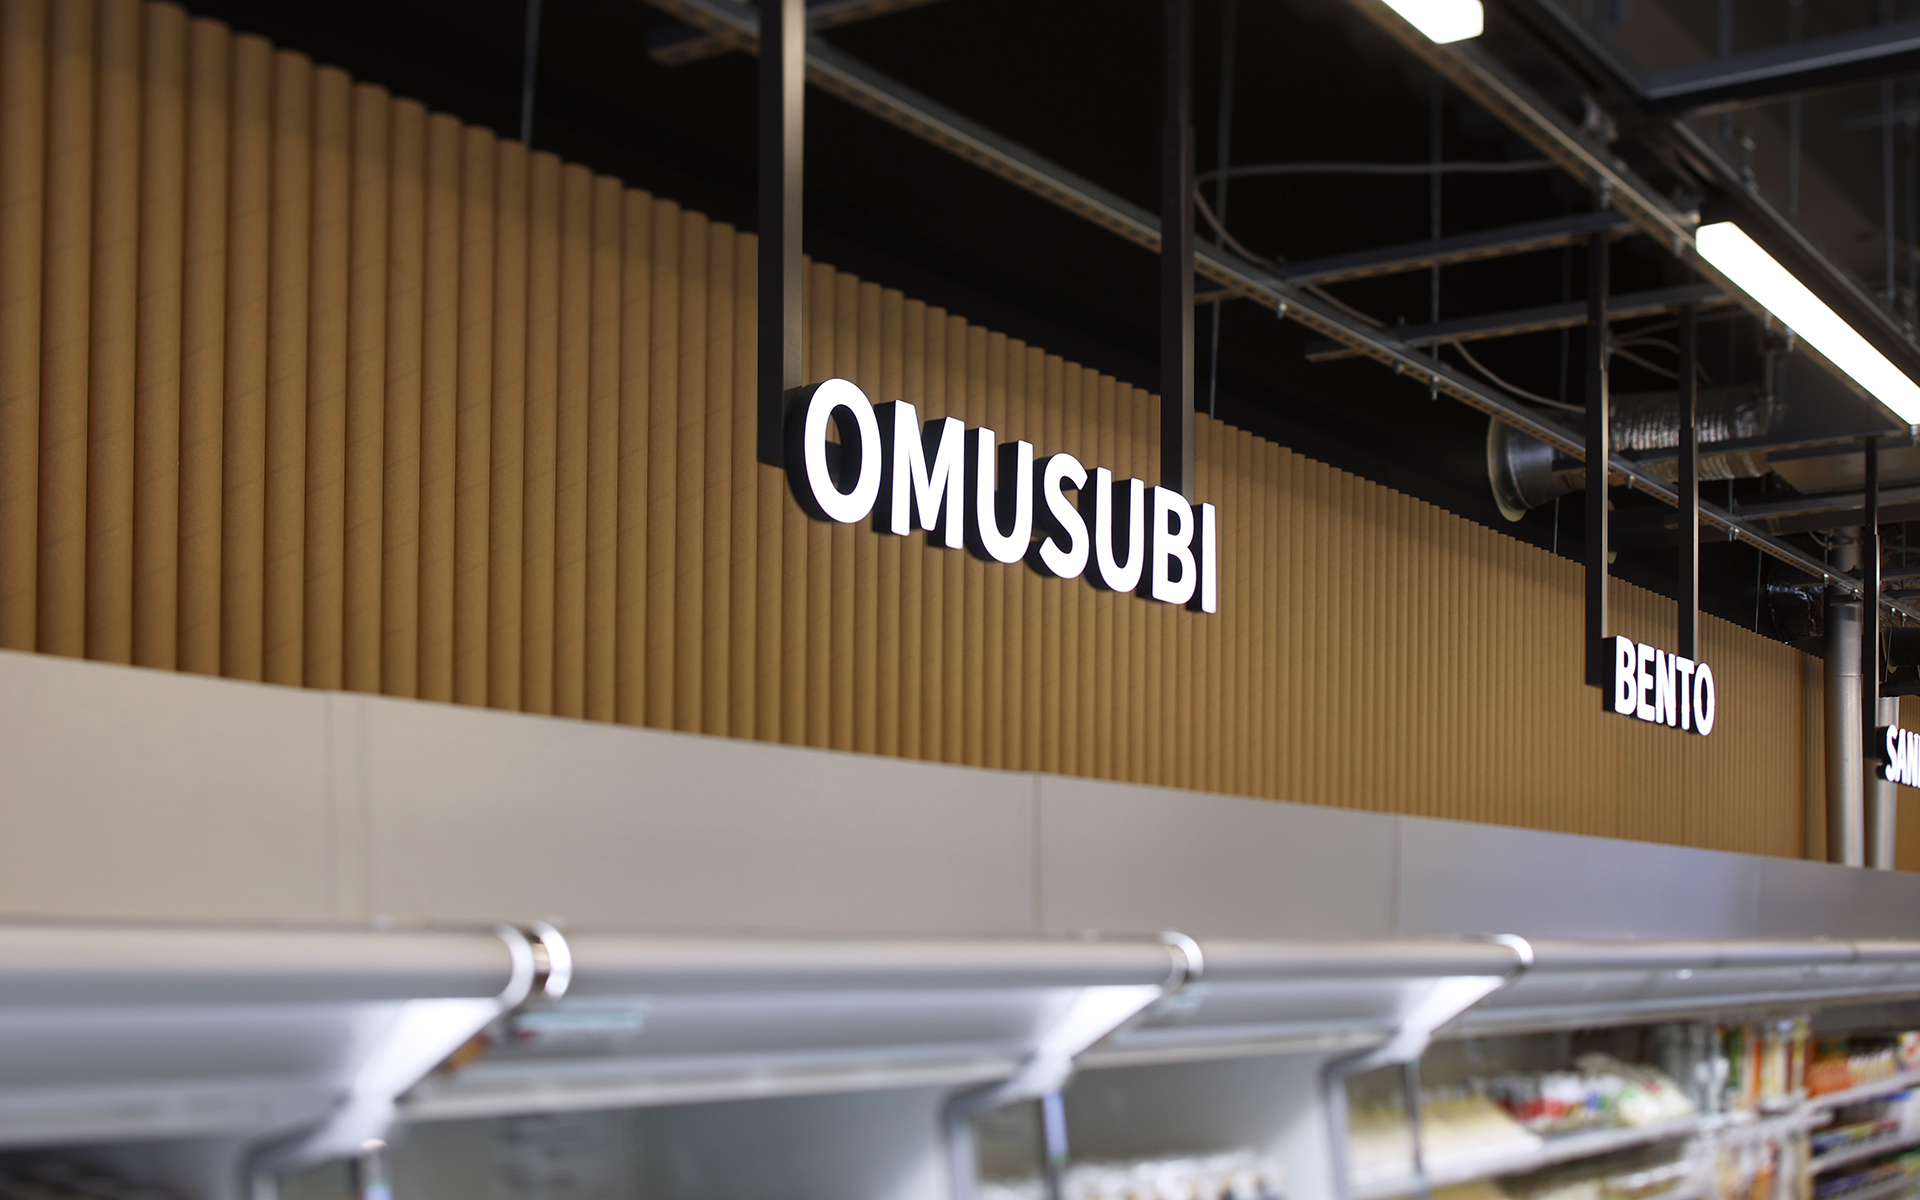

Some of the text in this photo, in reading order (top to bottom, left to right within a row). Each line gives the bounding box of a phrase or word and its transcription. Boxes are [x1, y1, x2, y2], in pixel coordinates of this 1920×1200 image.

[804, 378, 1217, 614] OMUSUBI
[1614, 634, 1716, 737] BENTO
[1884, 724, 1920, 789] SAN
